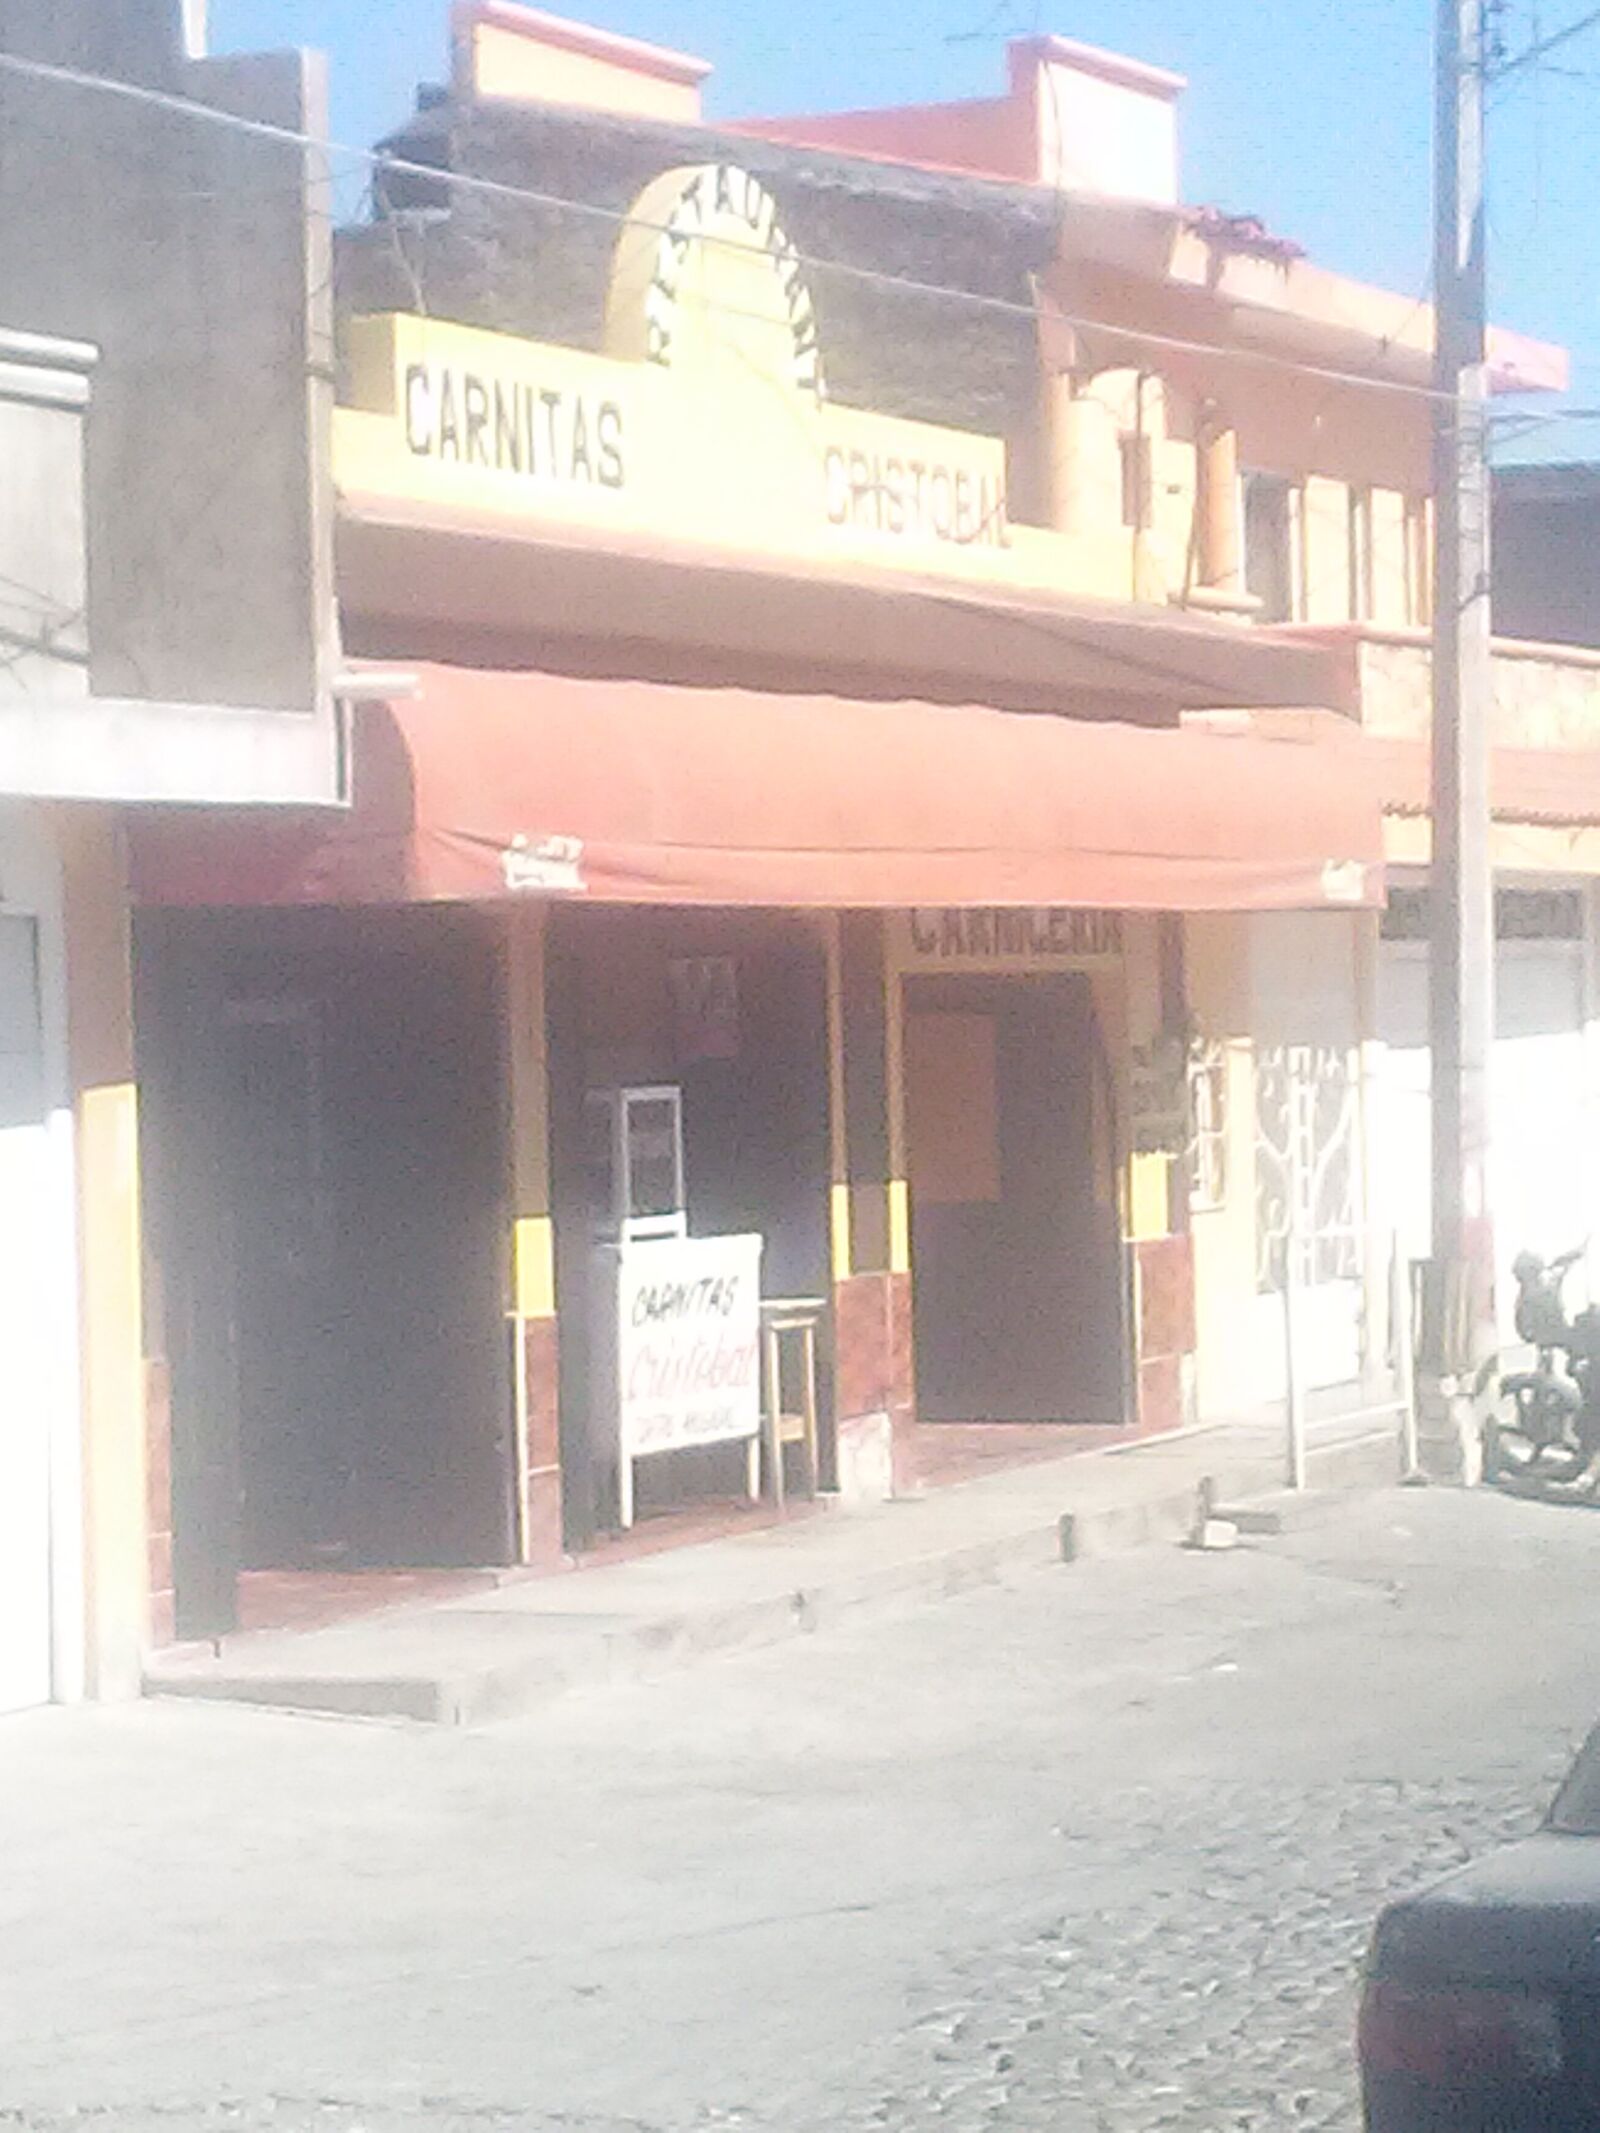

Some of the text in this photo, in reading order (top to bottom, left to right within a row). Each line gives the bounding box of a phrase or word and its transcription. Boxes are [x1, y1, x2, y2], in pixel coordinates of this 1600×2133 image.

[405, 363, 1012, 549] CARNITAS CRISTOBAL
[632, 1275, 740, 1328] CARNITAS
